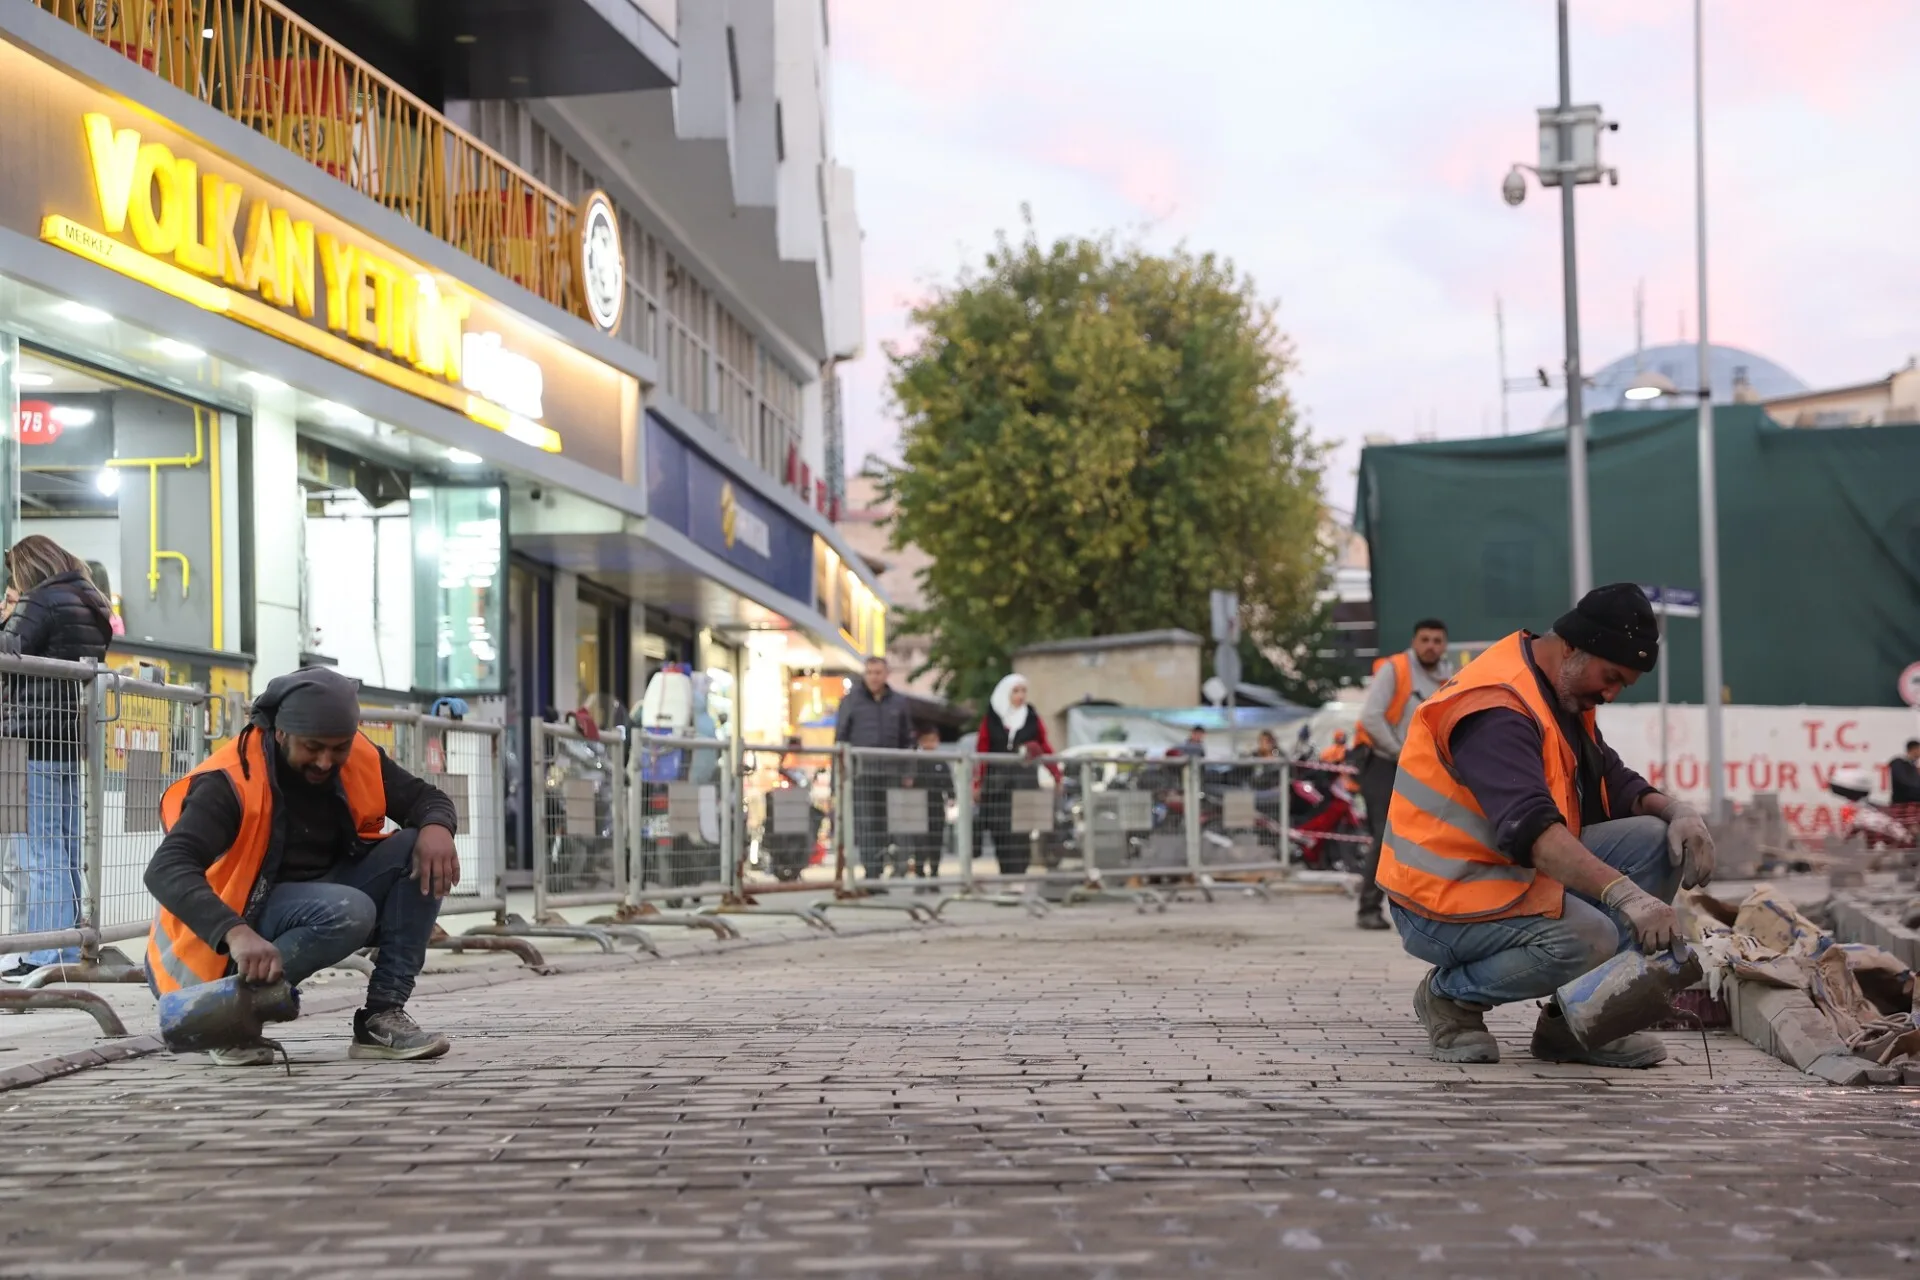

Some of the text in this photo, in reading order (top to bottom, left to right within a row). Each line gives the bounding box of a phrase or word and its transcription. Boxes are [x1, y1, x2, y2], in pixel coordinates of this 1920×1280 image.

[82, 112, 315, 318] VOLKAN
[65, 224, 113, 257] MERKEZ
[1804, 720, 1868, 750] T.C.
